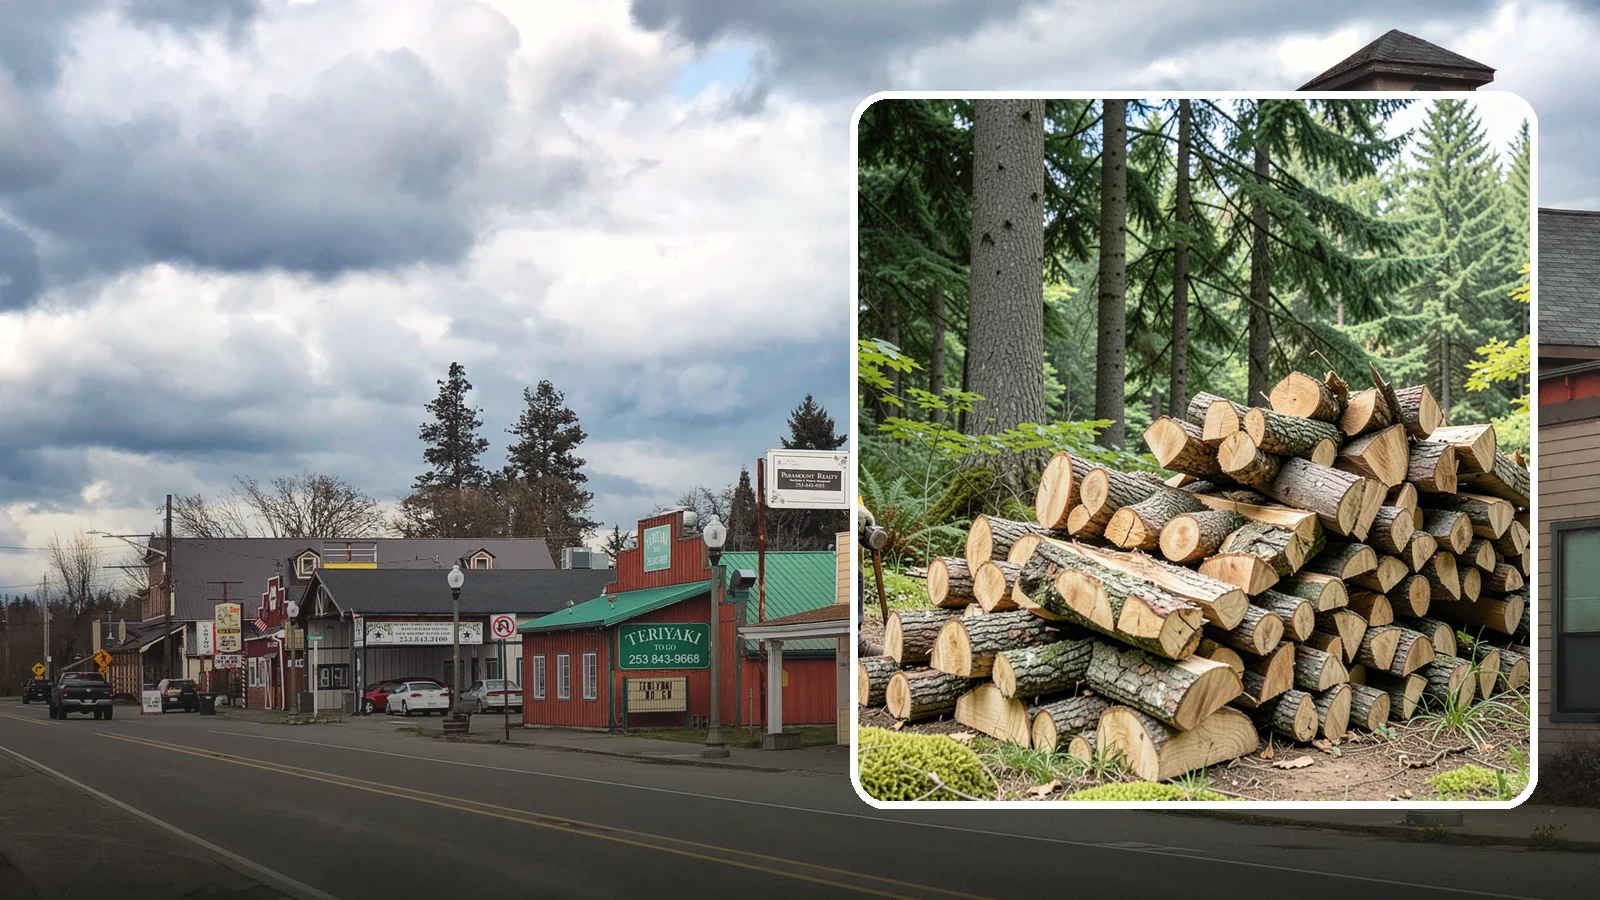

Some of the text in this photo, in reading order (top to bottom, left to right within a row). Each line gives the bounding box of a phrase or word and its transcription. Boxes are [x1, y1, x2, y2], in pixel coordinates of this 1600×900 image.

[781, 471, 838, 480] PARAMOUNT REALTY
[646, 531, 668, 549] TERIYAKI
[625, 628, 702, 646] TERIYAKI
[628, 654, 700, 664] 253 843-9668
[639, 681, 672, 691] TERIYAKI
